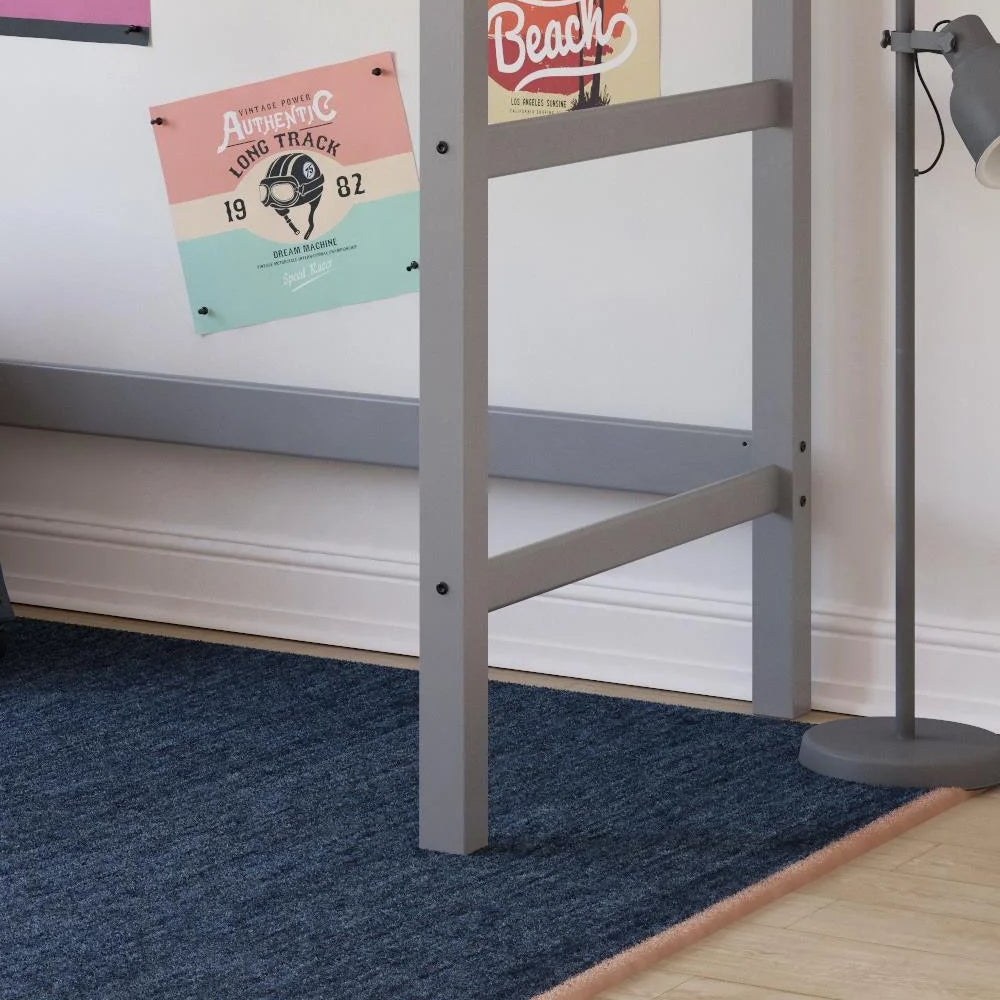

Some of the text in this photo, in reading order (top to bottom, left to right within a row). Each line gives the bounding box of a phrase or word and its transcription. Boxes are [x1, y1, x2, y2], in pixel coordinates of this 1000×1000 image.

[238, 93, 311, 117] VINTAGE POWER
[510, 98, 520, 106] LOS
[522, 98, 544, 107] ANGELES
[229, 131, 341, 179] LONG TRACK
[224, 172, 366, 222] 19 82
[273, 246, 301, 259] DREAM
[302, 238, 338, 253] MACHINE
